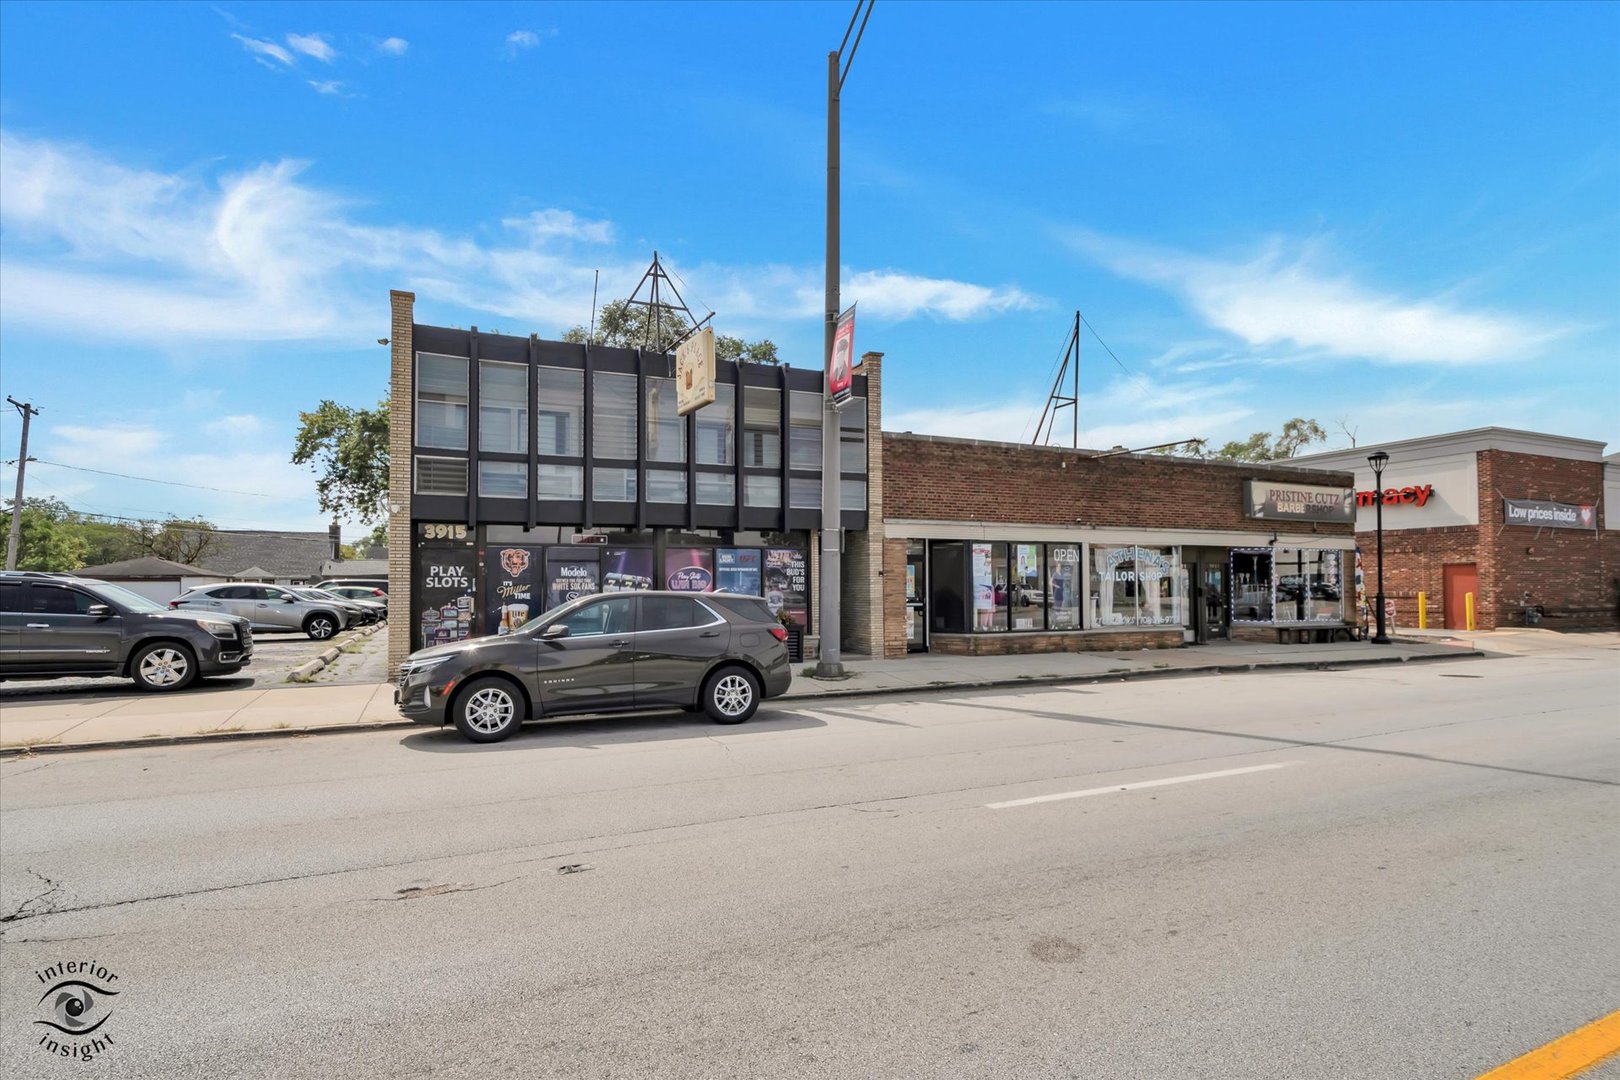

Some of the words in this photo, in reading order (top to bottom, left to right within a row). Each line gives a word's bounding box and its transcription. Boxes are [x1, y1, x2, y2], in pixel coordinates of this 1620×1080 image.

[1269, 489, 1313, 503] PRISTINE
[1315, 493, 1340, 505] CUTZ
[1508, 504, 1527, 518] Low
[1527, 506, 1553, 522] prices
[1553, 507, 1577, 521] inside
[424, 524, 467, 539] 3915
[1053, 548, 1080, 562] OPEN
[791, 561, 805, 569] THIS
[430, 566, 464, 577] PLAY
[560, 566, 588, 577] Modelo
[786, 568, 805, 576] BUD'S
[1099, 571, 1135, 582] TAILOR
[1139, 571, 1163, 581] SHOP
[426, 577, 468, 588] SLOTS
[792, 576, 805, 584] FOR
[497, 584, 532, 598] Miller
[792, 584, 805, 592] YOU
[514, 592, 531, 600] TIME
